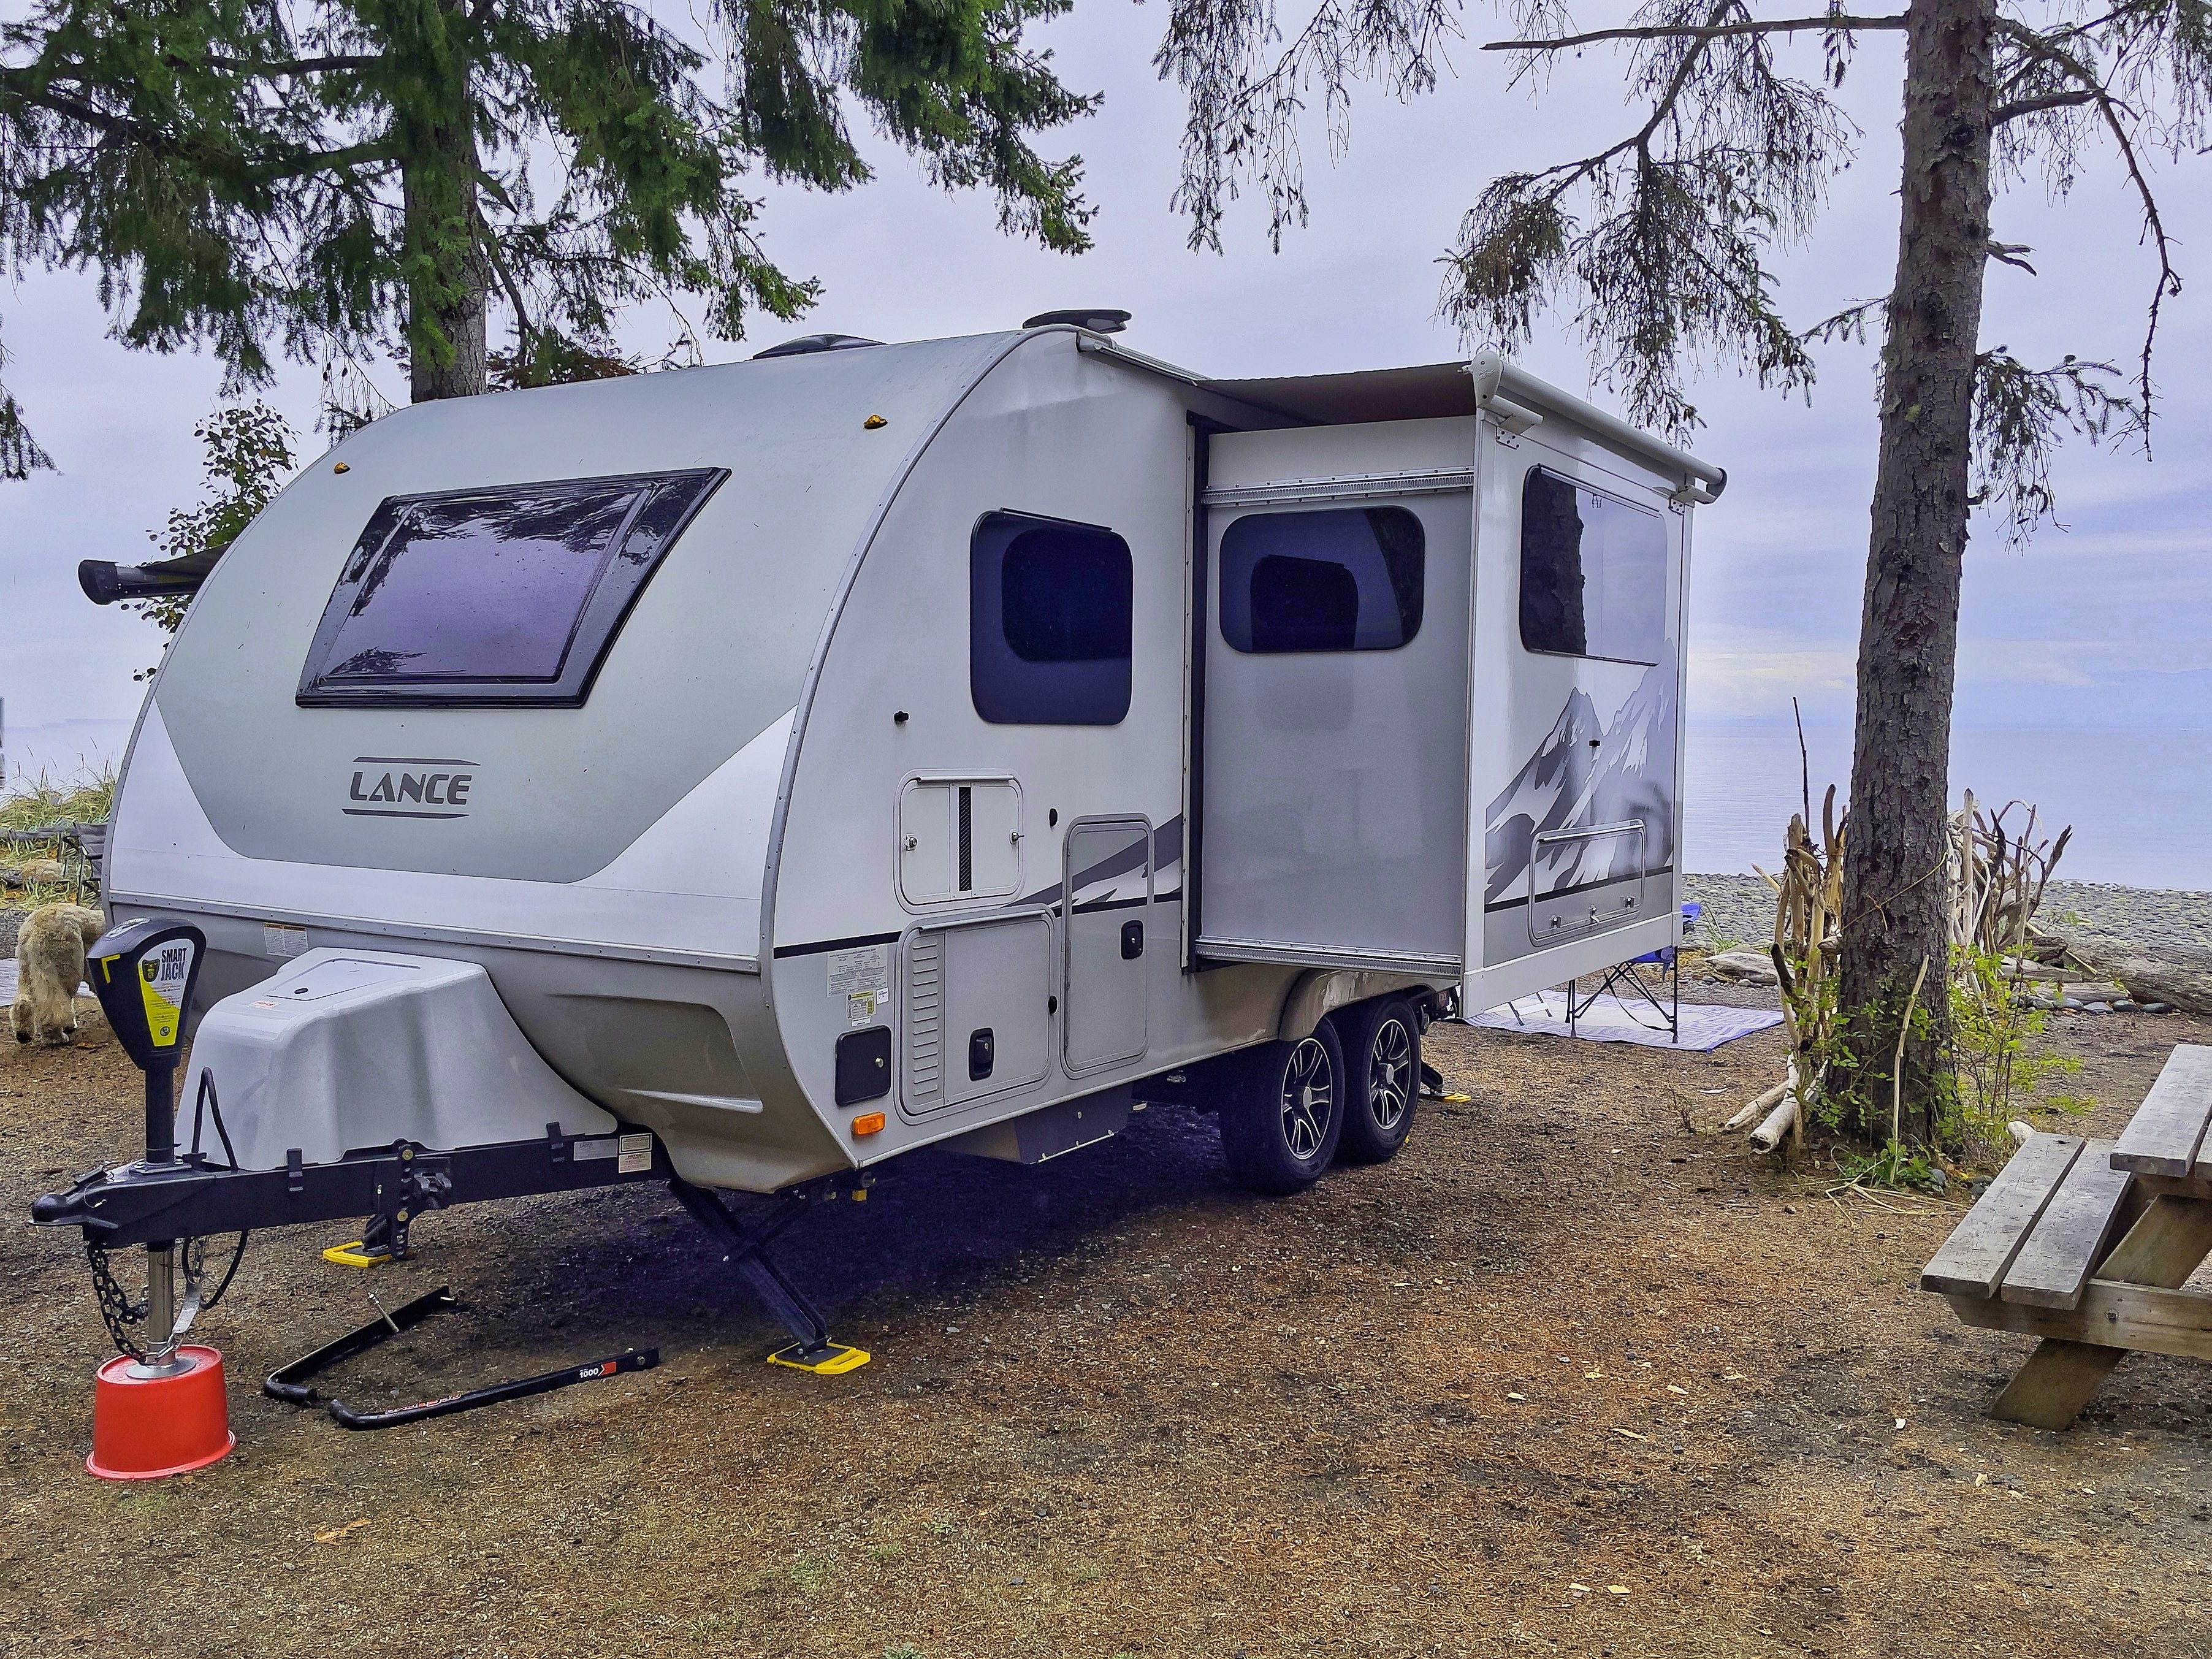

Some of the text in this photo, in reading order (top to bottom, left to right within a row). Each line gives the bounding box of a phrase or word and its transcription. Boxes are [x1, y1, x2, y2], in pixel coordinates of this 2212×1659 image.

[350, 771, 472, 805] LANCE
[161, 947, 187, 963] SMART
[160, 961, 185, 981] JACK
[579, 1368, 599, 1378] 1000
